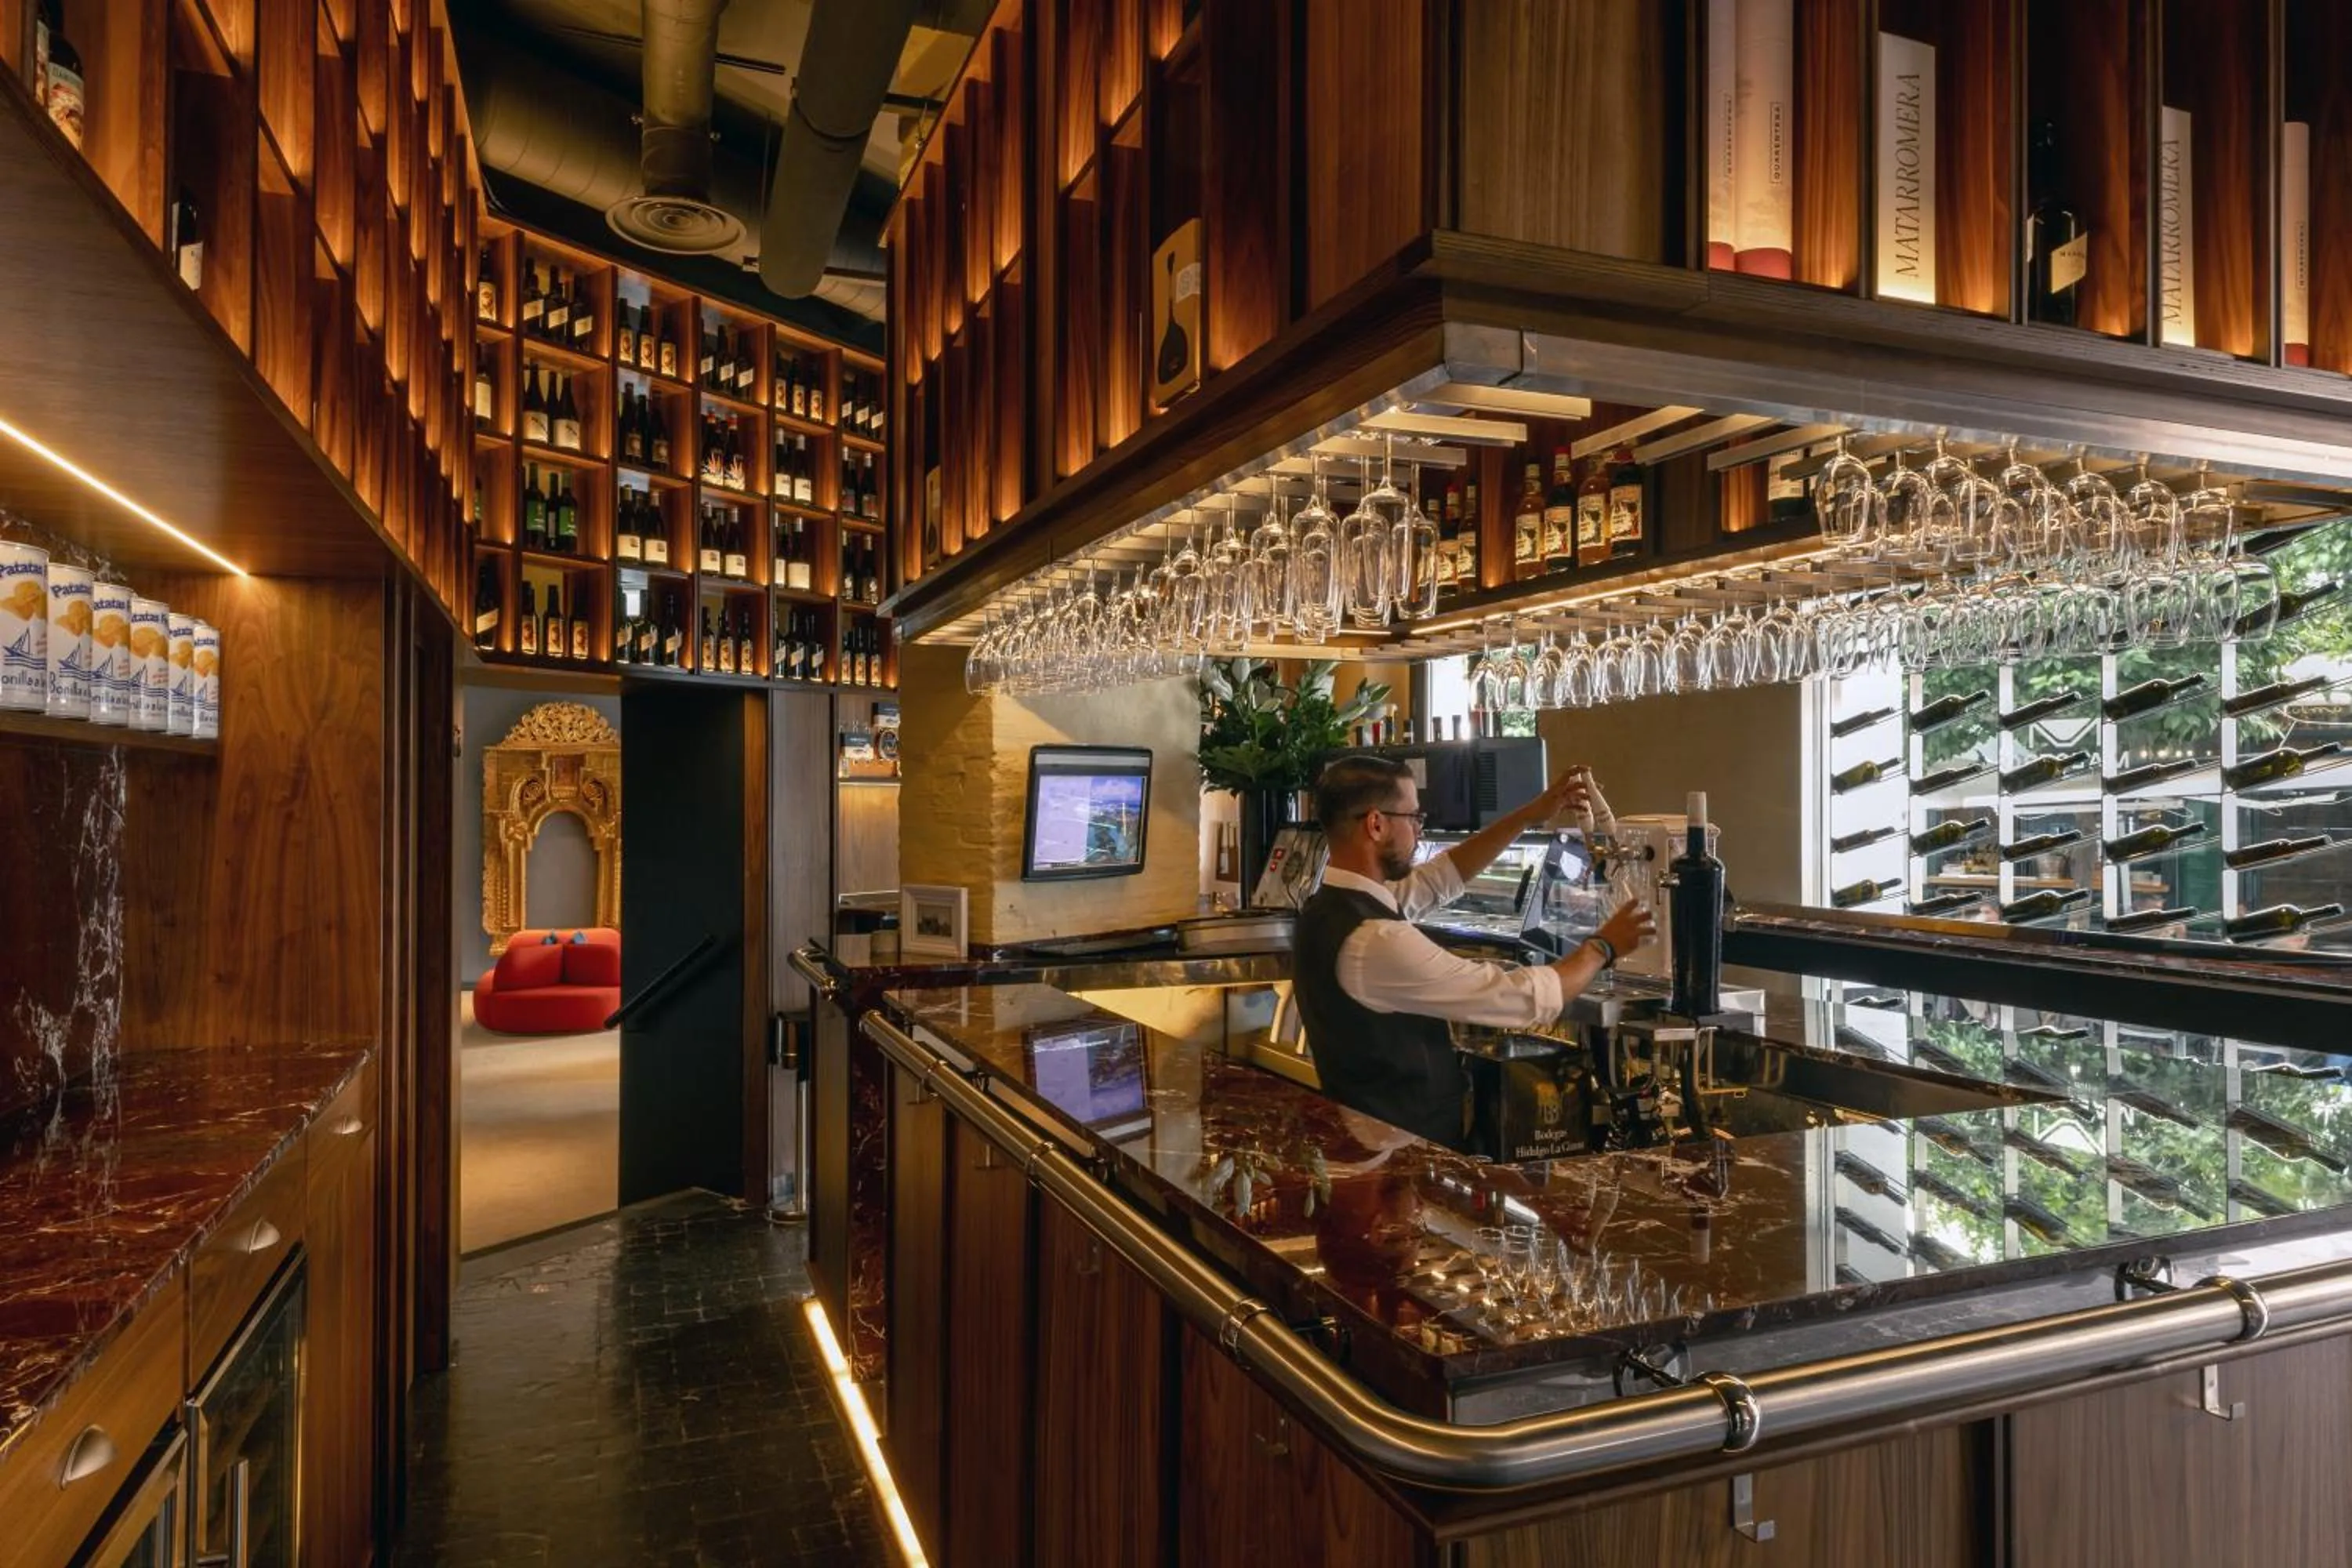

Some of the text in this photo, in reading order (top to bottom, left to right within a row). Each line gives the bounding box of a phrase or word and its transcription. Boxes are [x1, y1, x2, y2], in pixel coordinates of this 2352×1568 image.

[1895, 74, 1920, 278] MATARROMERA
[2161, 139, 2182, 327] MATARROMERA
[93, 598, 125, 610] atatas
